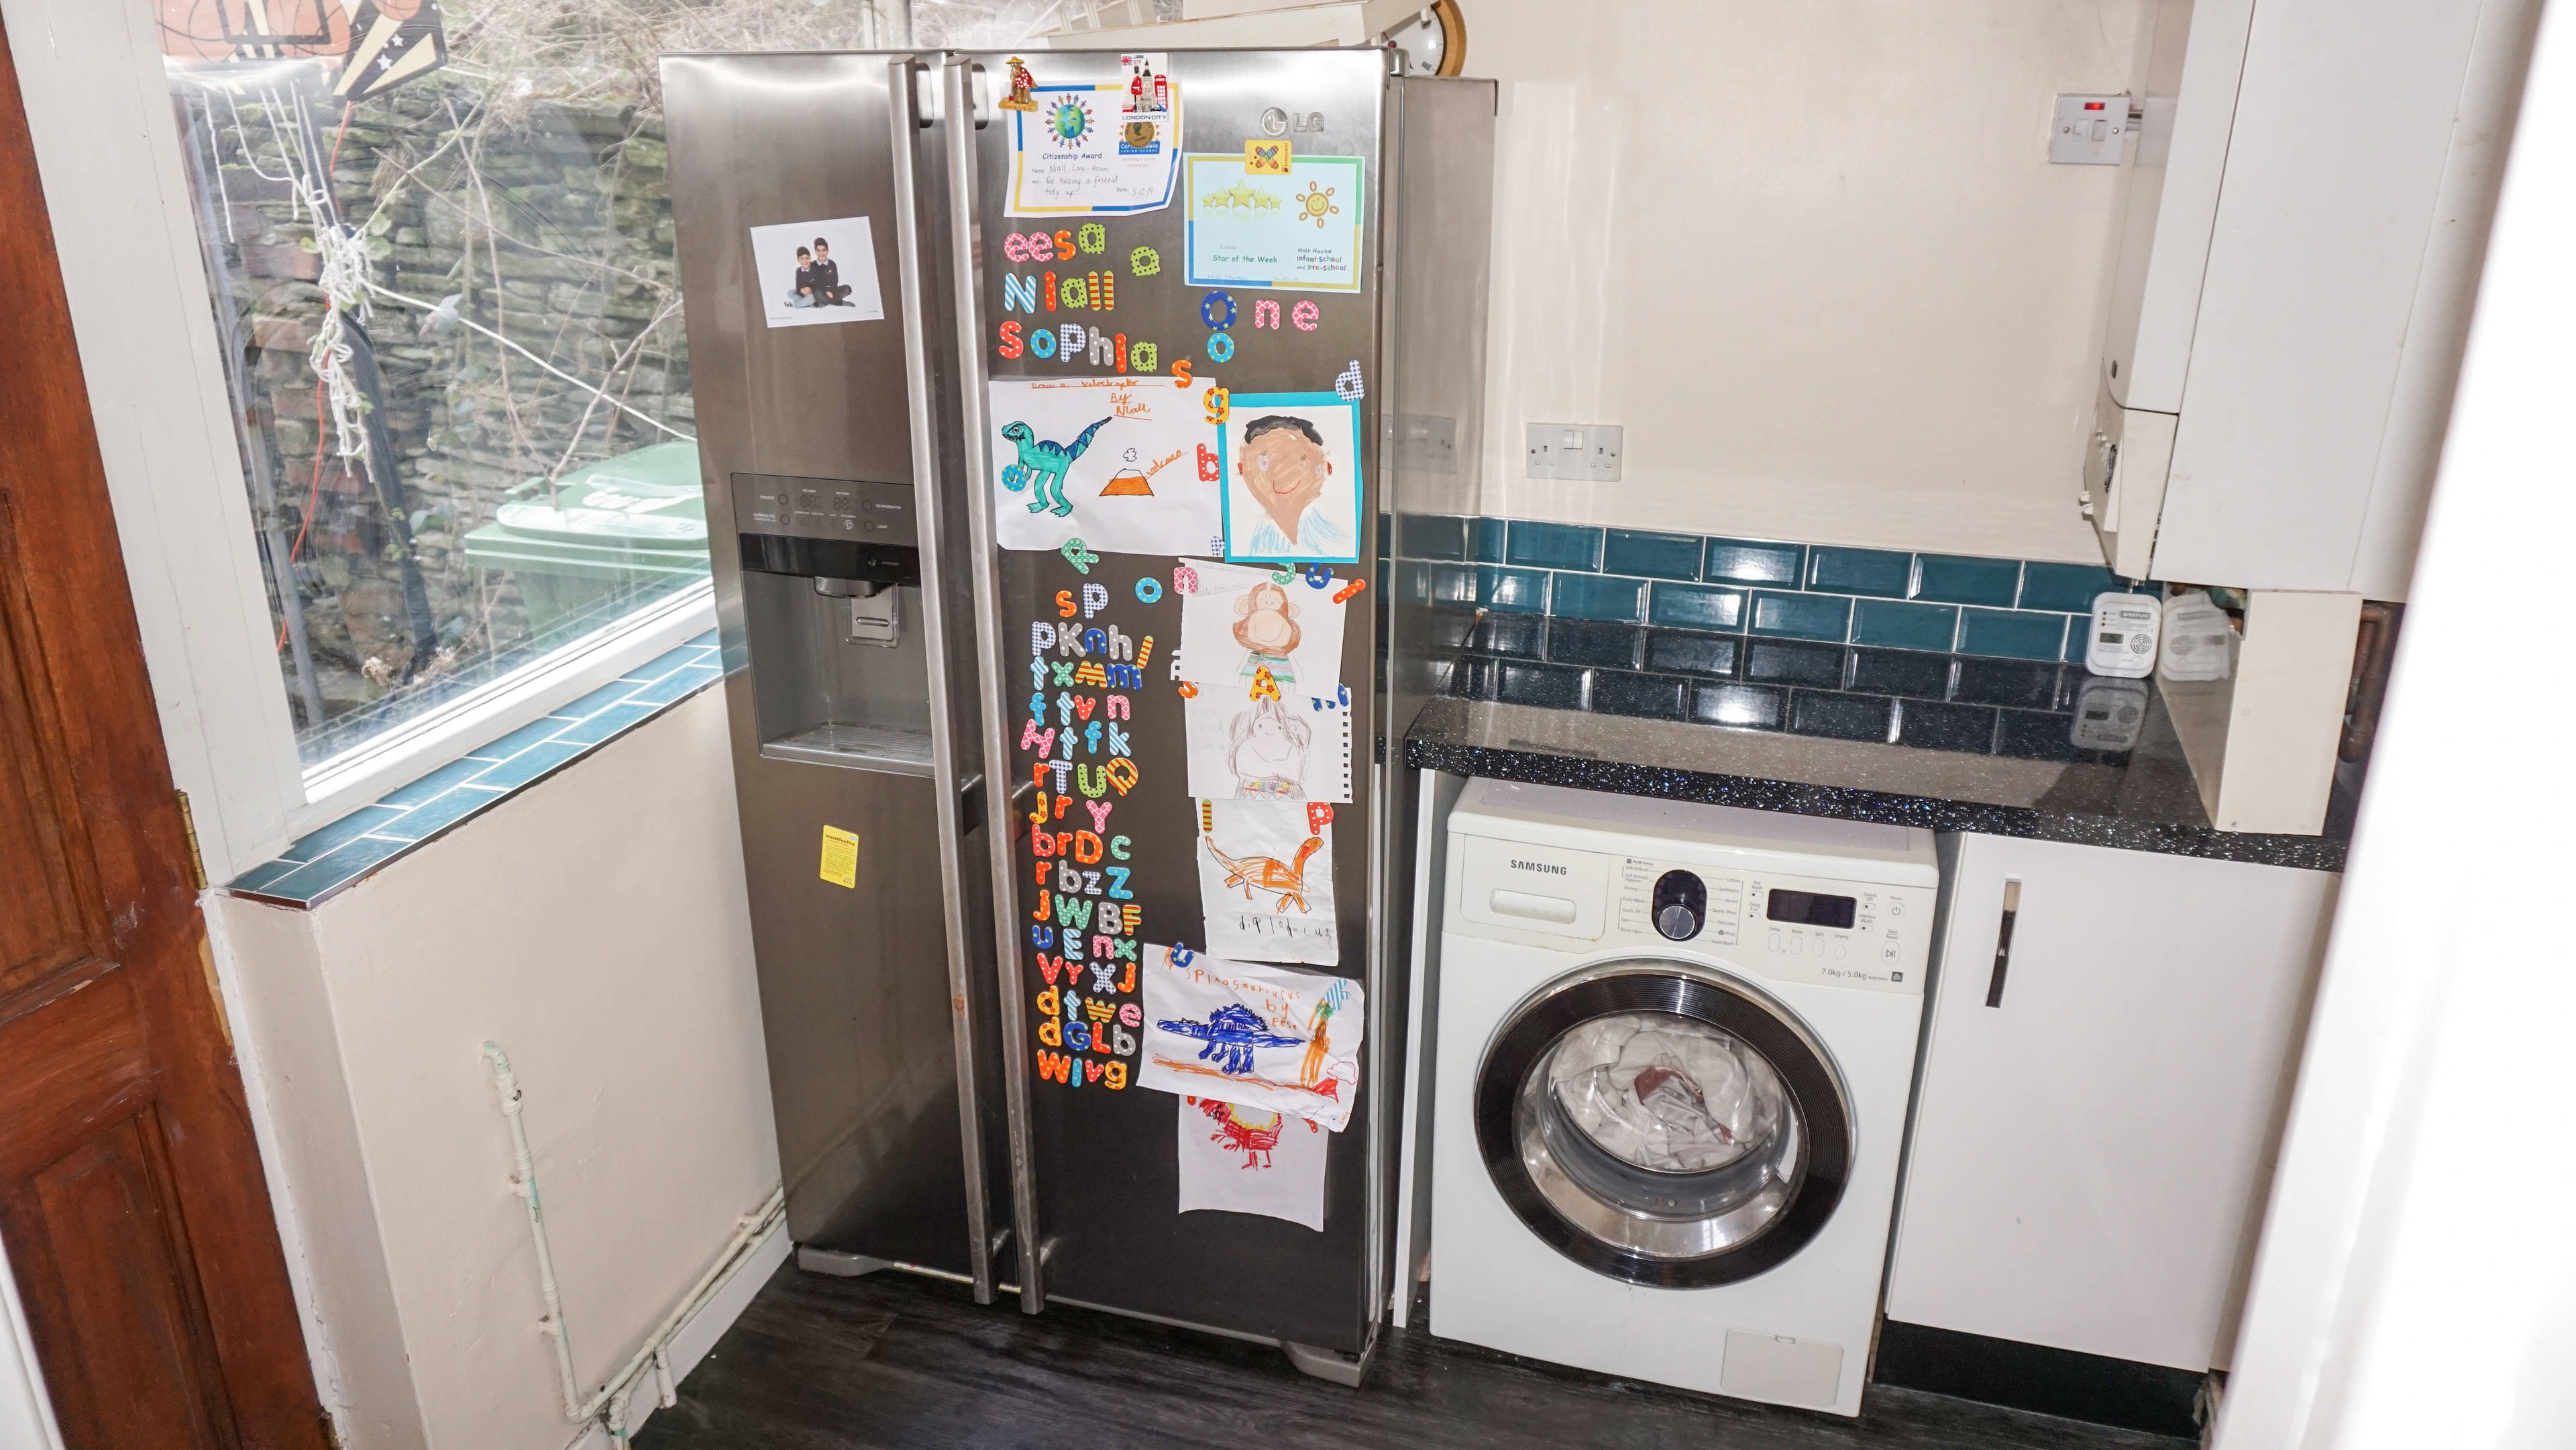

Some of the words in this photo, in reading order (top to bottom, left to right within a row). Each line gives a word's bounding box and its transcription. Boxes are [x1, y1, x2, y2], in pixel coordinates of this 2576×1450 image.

[1293, 112, 1324, 132] LG
[1049, 164, 1066, 172] Niall
[1093, 175, 1118, 188] friend
[1116, 403, 1151, 415] Niall
[1510, 860, 1567, 876] SAMSUNG
[1822, 968, 1841, 978] 7.0kg
[1847, 971, 1867, 980] 5.0kg
